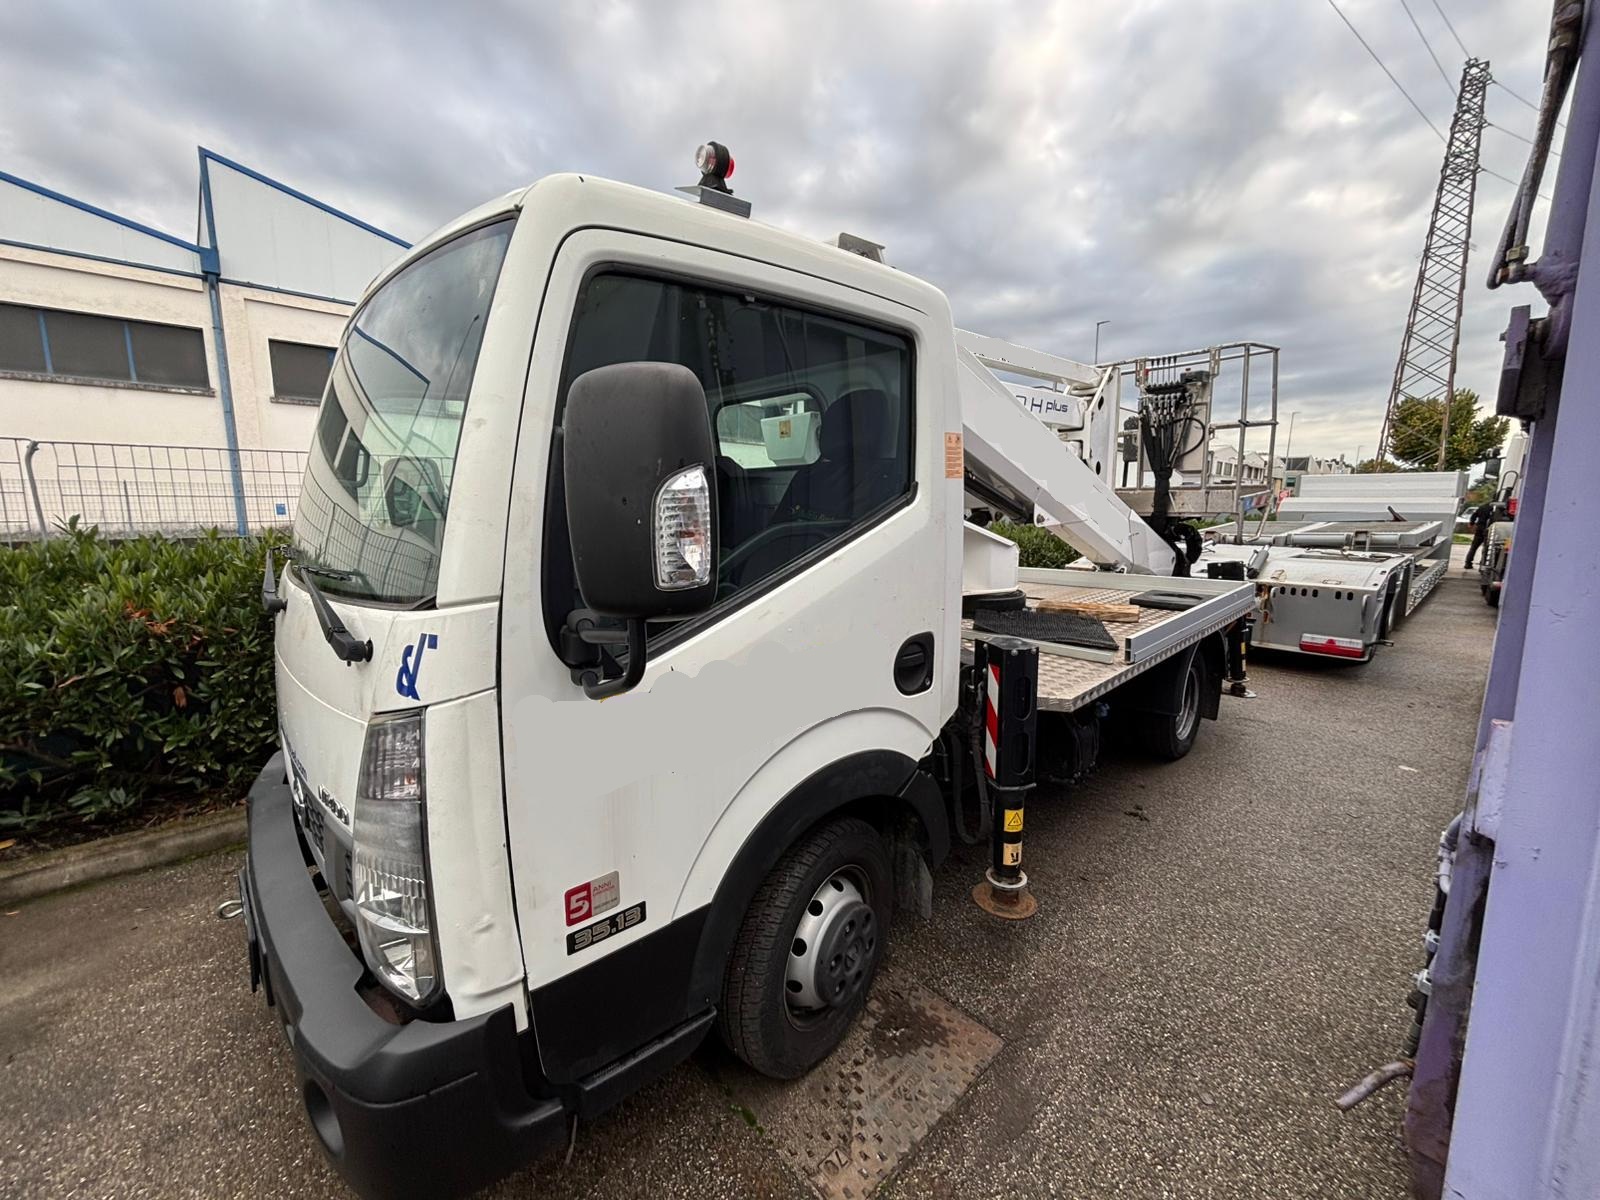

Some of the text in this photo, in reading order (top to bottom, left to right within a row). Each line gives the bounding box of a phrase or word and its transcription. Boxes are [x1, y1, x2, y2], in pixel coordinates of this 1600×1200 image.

[1046, 399, 1069, 413] plus
[569, 891, 590, 919] 5
[574, 906, 641, 950] 35.13
